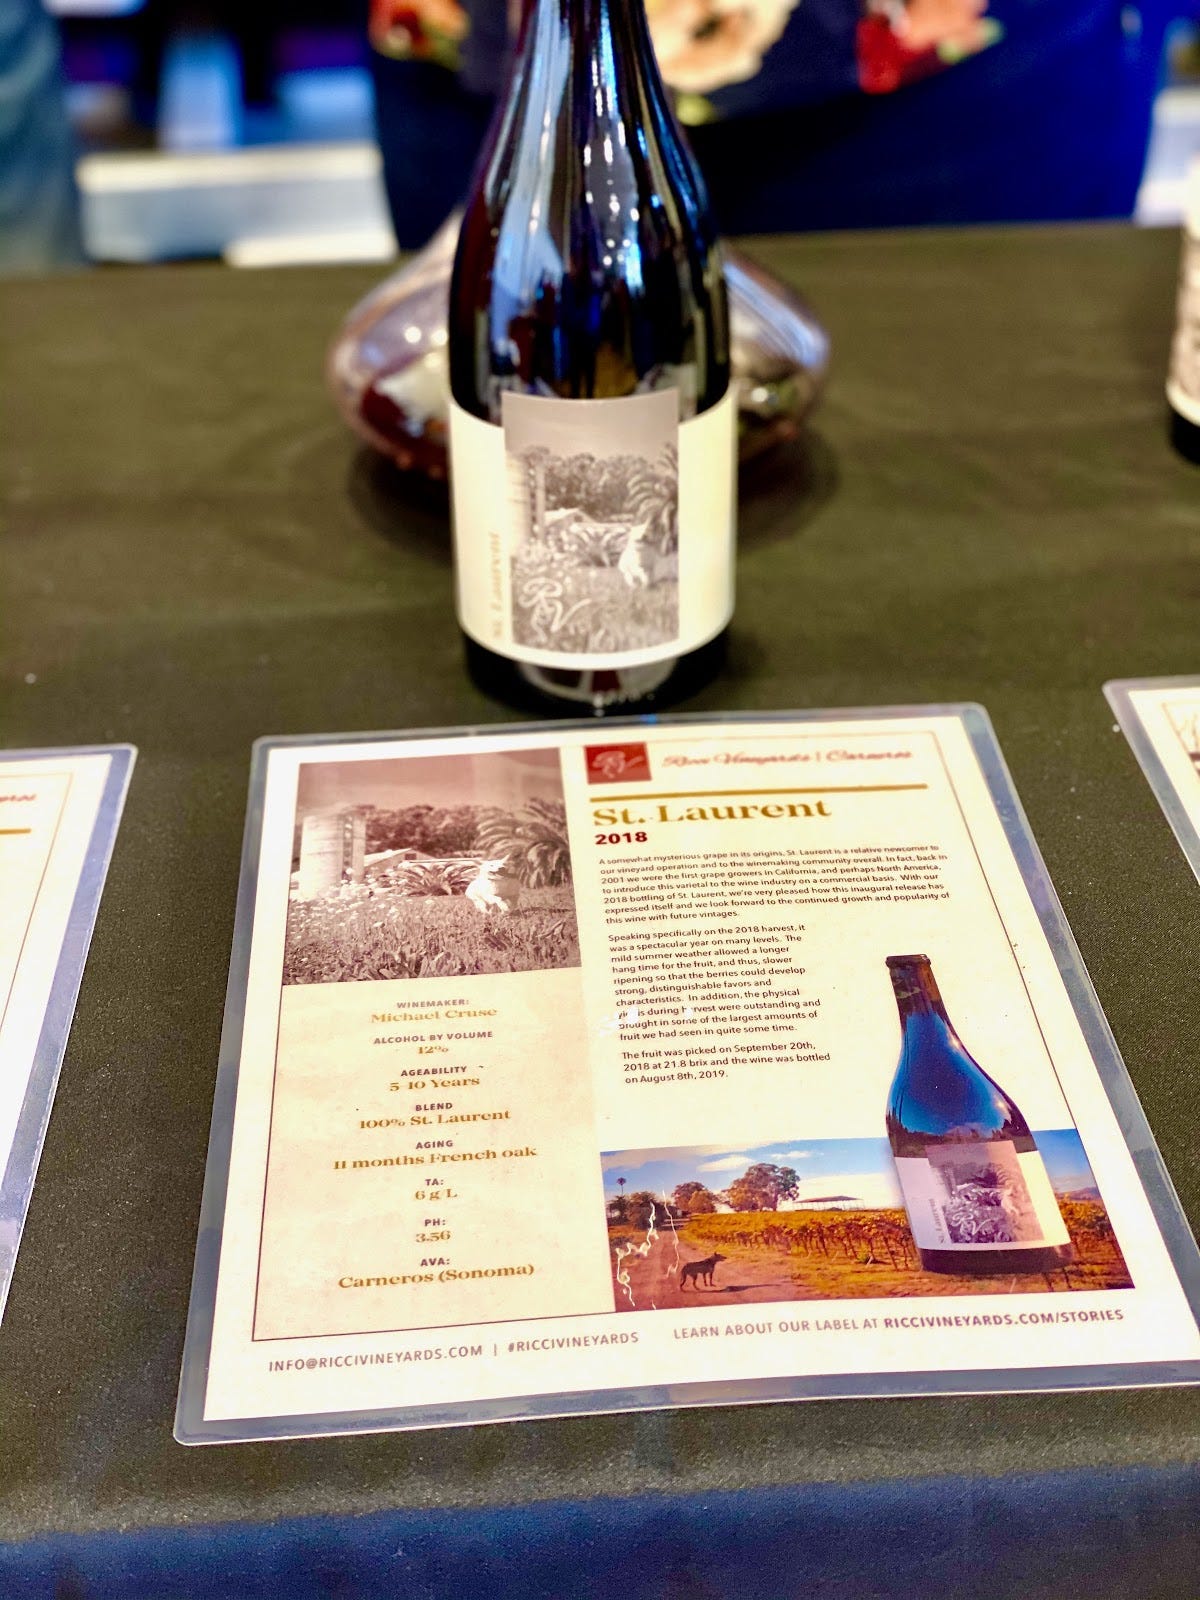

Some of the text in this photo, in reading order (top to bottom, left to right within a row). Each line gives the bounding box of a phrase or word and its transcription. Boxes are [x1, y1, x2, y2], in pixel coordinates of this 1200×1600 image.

[593, 799, 831, 826] St. Laurent
[595, 831, 648, 845] 2018
[605, 904, 649, 915] expressed
[651, 902, 673, 911] itself
[675, 901, 692, 909] and
[709, 899, 729, 907] look
[729, 898, 764, 906] forward
[794, 895, 839, 904] continued
[841, 894, 872, 904] growth
[874, 894, 891, 902] and
[893, 892, 938, 902] popularity
[606, 916, 622, 924] this
[624, 914, 646, 923] wine
[648, 913, 667, 921] with
[608, 932, 650, 943] Speaking
[652, 928, 702, 940] specifically
[734, 925, 760, 934] 2018
[761, 924, 797, 932] harvest,
[636, 941, 687, 952] spectacular
[689, 940, 708, 949] year
[752, 935, 782, 943] levels.
[611, 954, 632, 962] mild
[634, 952, 672, 961] summer
[674, 950, 711, 958] weather
[713, 947, 750, 956] allowed
[759, 946, 789, 955] longer
[612, 966, 636, 974] hang
[692, 959, 716, 968] fruit,
[717, 958, 735, 966] and
[737, 958, 760, 966] thus,
[614, 975, 653, 986] ripening
[668, 972, 687, 981] that
[706, 969, 738, 978] berries
[740, 968, 766, 976] could
[768, 966, 806, 976] develop
[615, 987, 647, 996] strong,
[649, 981, 721, 993] distinguishable
[753, 978, 772, 986] and
[700, 992, 742, 1001] addition,
[744, 990, 759, 998] the
[762, 988, 800, 999] physical
[397, 999, 469, 1008] WINEMAKER:
[647, 1007, 681, 1016] during
[680, 1004, 716, 1014] hrvest
[743, 1000, 800, 1010] outstanding
[802, 999, 821, 1007] and
[371, 1008, 498, 1023] Michael Cruse
[699, 1016, 708, 1024] of
[711, 1015, 727, 1023] the
[729, 1013, 762, 1024] largest
[764, 1012, 806, 1020] amounts
[808, 1010, 818, 1018] of
[373, 1031, 493, 1044] ALCOHOL BY VOLUME
[620, 1032, 640, 1041] fruit
[658, 1029, 676, 1038] had
[702, 1027, 713, 1035] in
[716, 1026, 741, 1036] quite
[772, 1024, 798, 1032] time.
[417, 1045, 449, 1055] 12%
[622, 1051, 639, 1059] The
[641, 1050, 661, 1058] fruit
[685, 1046, 716, 1058] picked
[733, 1043, 786, 1054] September
[789, 1041, 816, 1050] 20th,
[624, 1062, 649, 1071] 2018
[664, 1059, 686, 1068] 21.8
[689, 1058, 707, 1067] brix
[710, 1057, 728, 1066] and
[731, 1056, 747, 1065] the
[749, 1056, 773, 1064] wine
[796, 1053, 831, 1062] bottled
[401, 1066, 467, 1077] AGEABILITY
[640, 1073, 674, 1084] August
[676, 1071, 696, 1080] 8th,
[698, 1068, 729, 1078] 2019.
[430, 1077, 480, 1088] Years
[415, 1102, 453, 1111] BLEND
[359, 1110, 511, 1129] 100% St. Laurent
[415, 1140, 454, 1149] AGING
[333, 1146, 537, 1170] 11 months French oak
[425, 1178, 444, 1186] TA:
[424, 1218, 446, 1227] PH:
[415, 1230, 451, 1243] 3.56
[420, 1258, 450, 1267] AVA:
[338, 1264, 535, 1288] Carneros (Sonoma)
[673, 1308, 1124, 1340] LEARN ABOUT OUR LABEL AT RICCIVINEYARDS.COM/STORIES
[268, 1332, 640, 1372] INFO@RICCIVINEYARDS.COM #RICCIVINEYARDS
